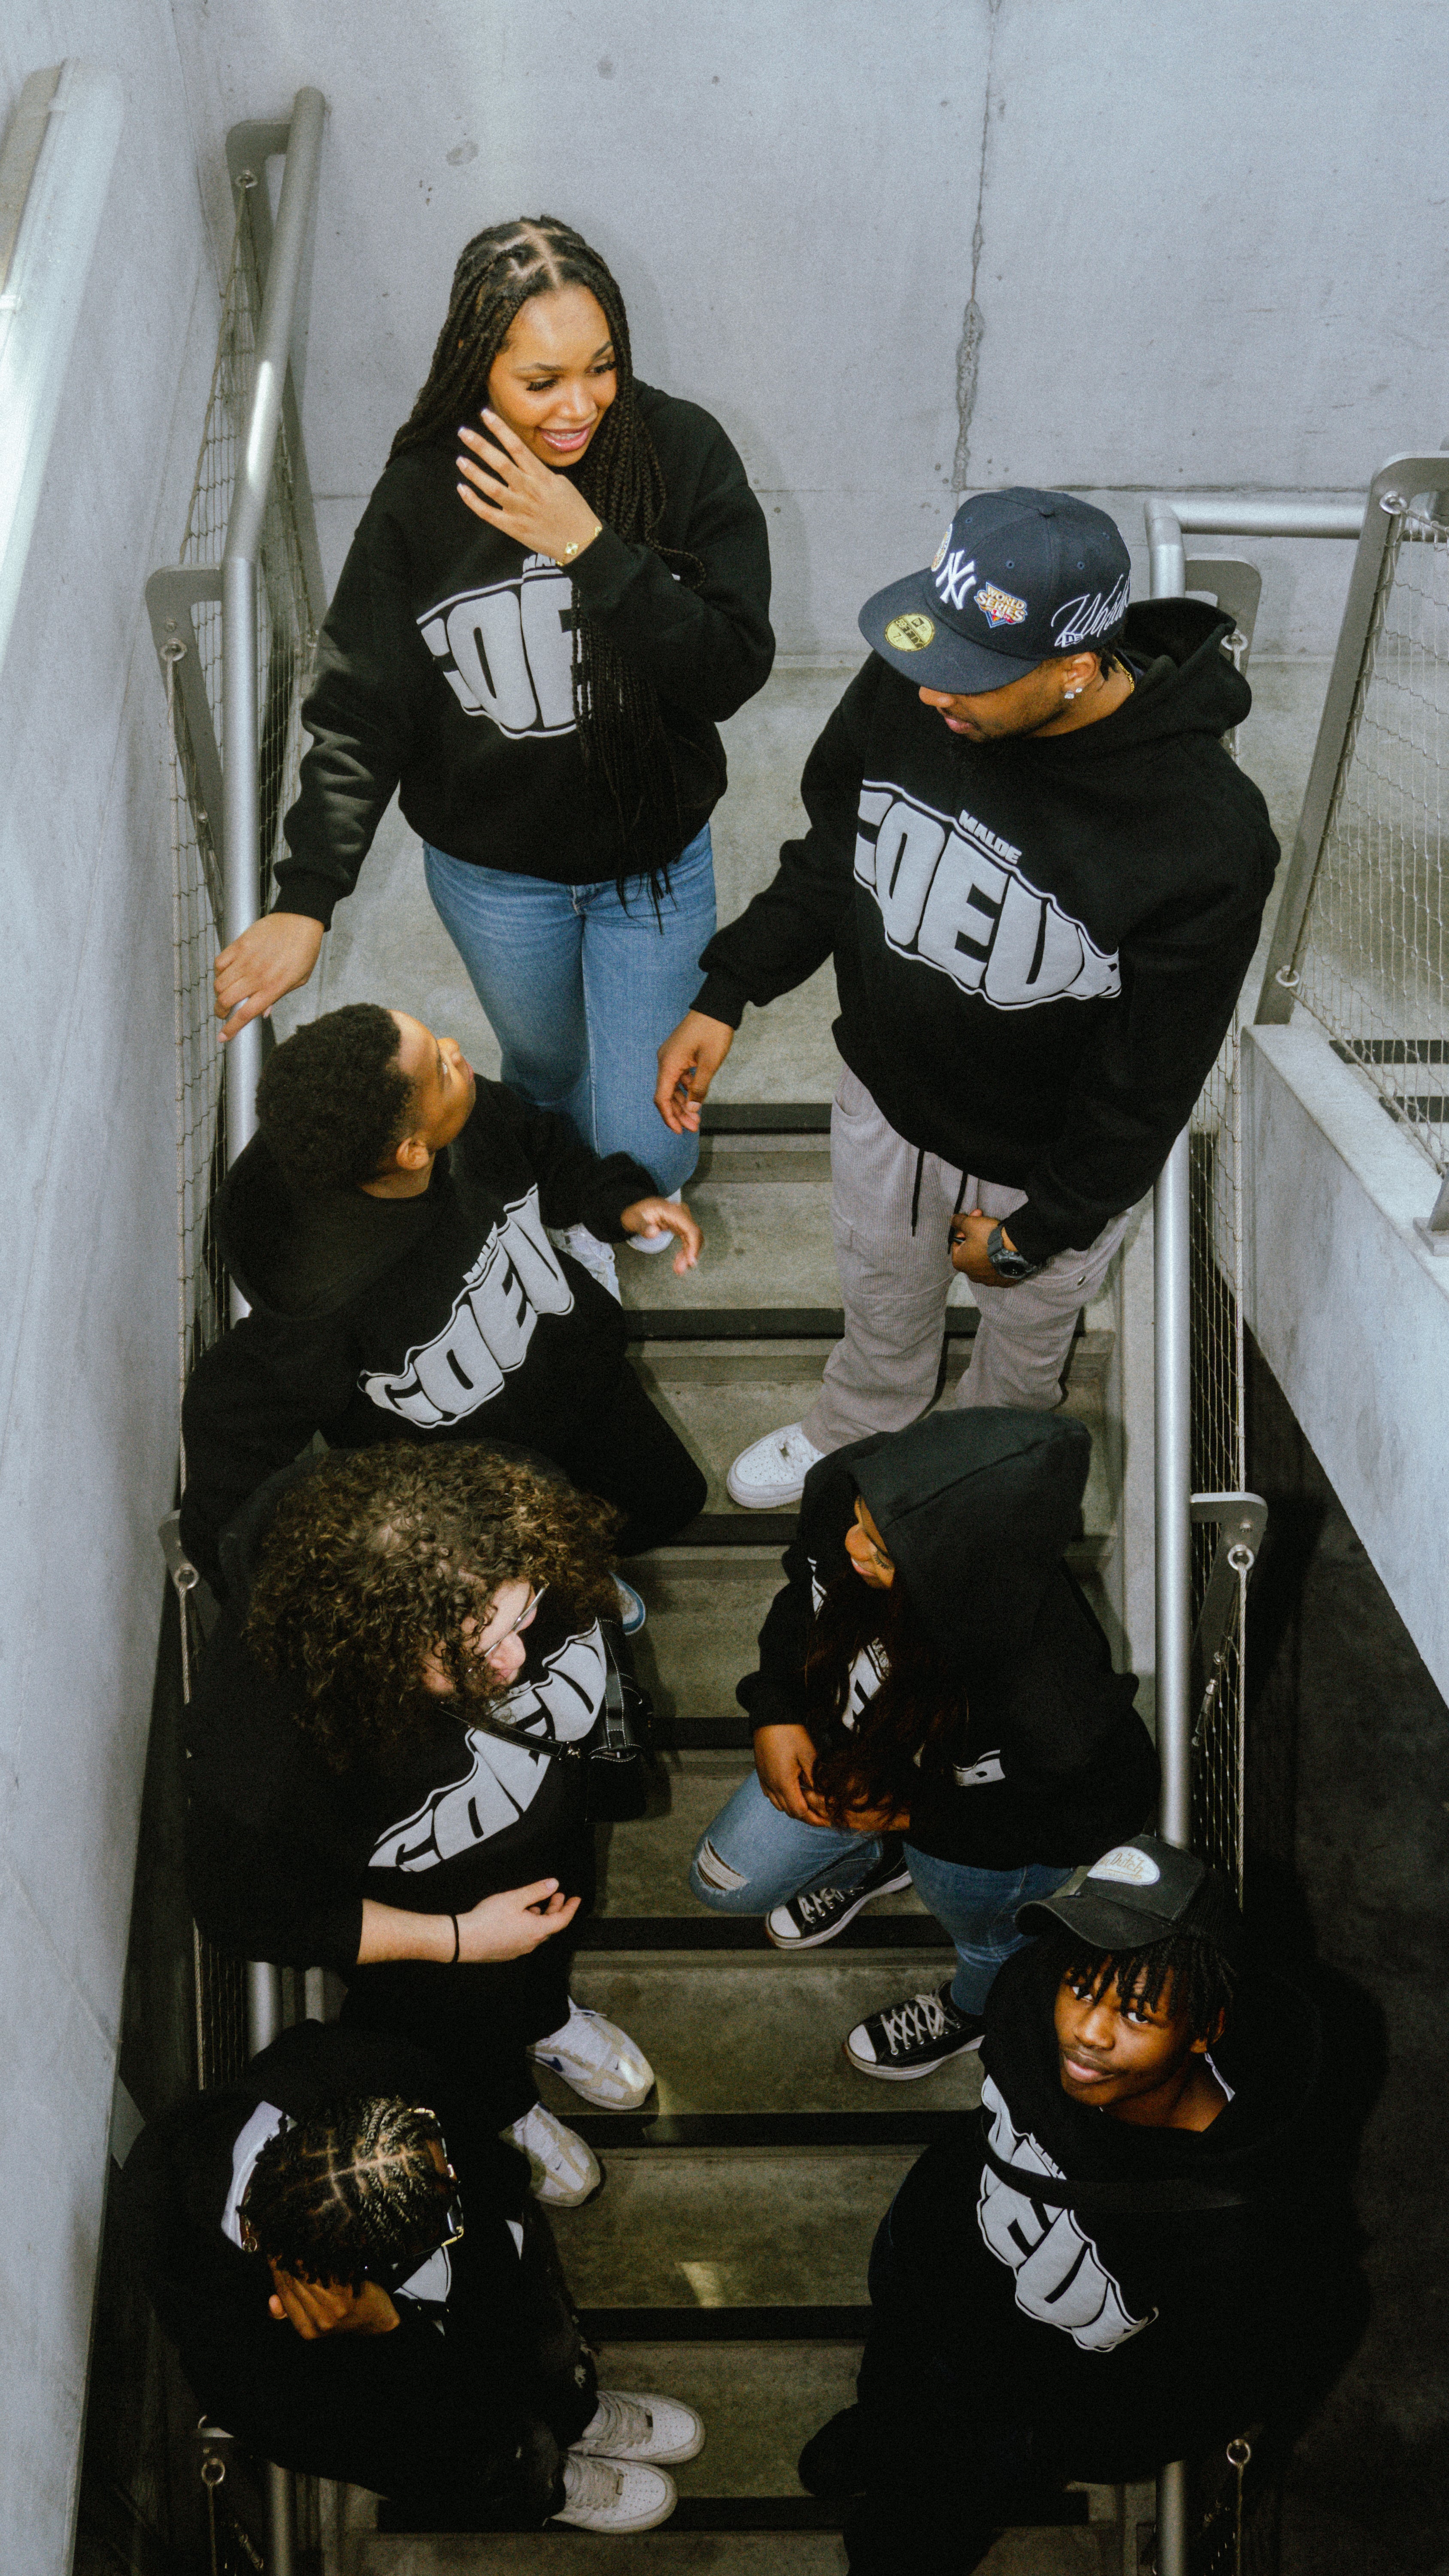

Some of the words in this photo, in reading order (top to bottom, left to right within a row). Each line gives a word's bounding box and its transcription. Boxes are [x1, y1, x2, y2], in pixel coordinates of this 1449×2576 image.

[935, 550, 977, 611] NY
[976, 591, 1026, 622] SERIES
[987, 585, 1025, 609] WORLD
[1110, 1852, 1145, 1876] Dutch
